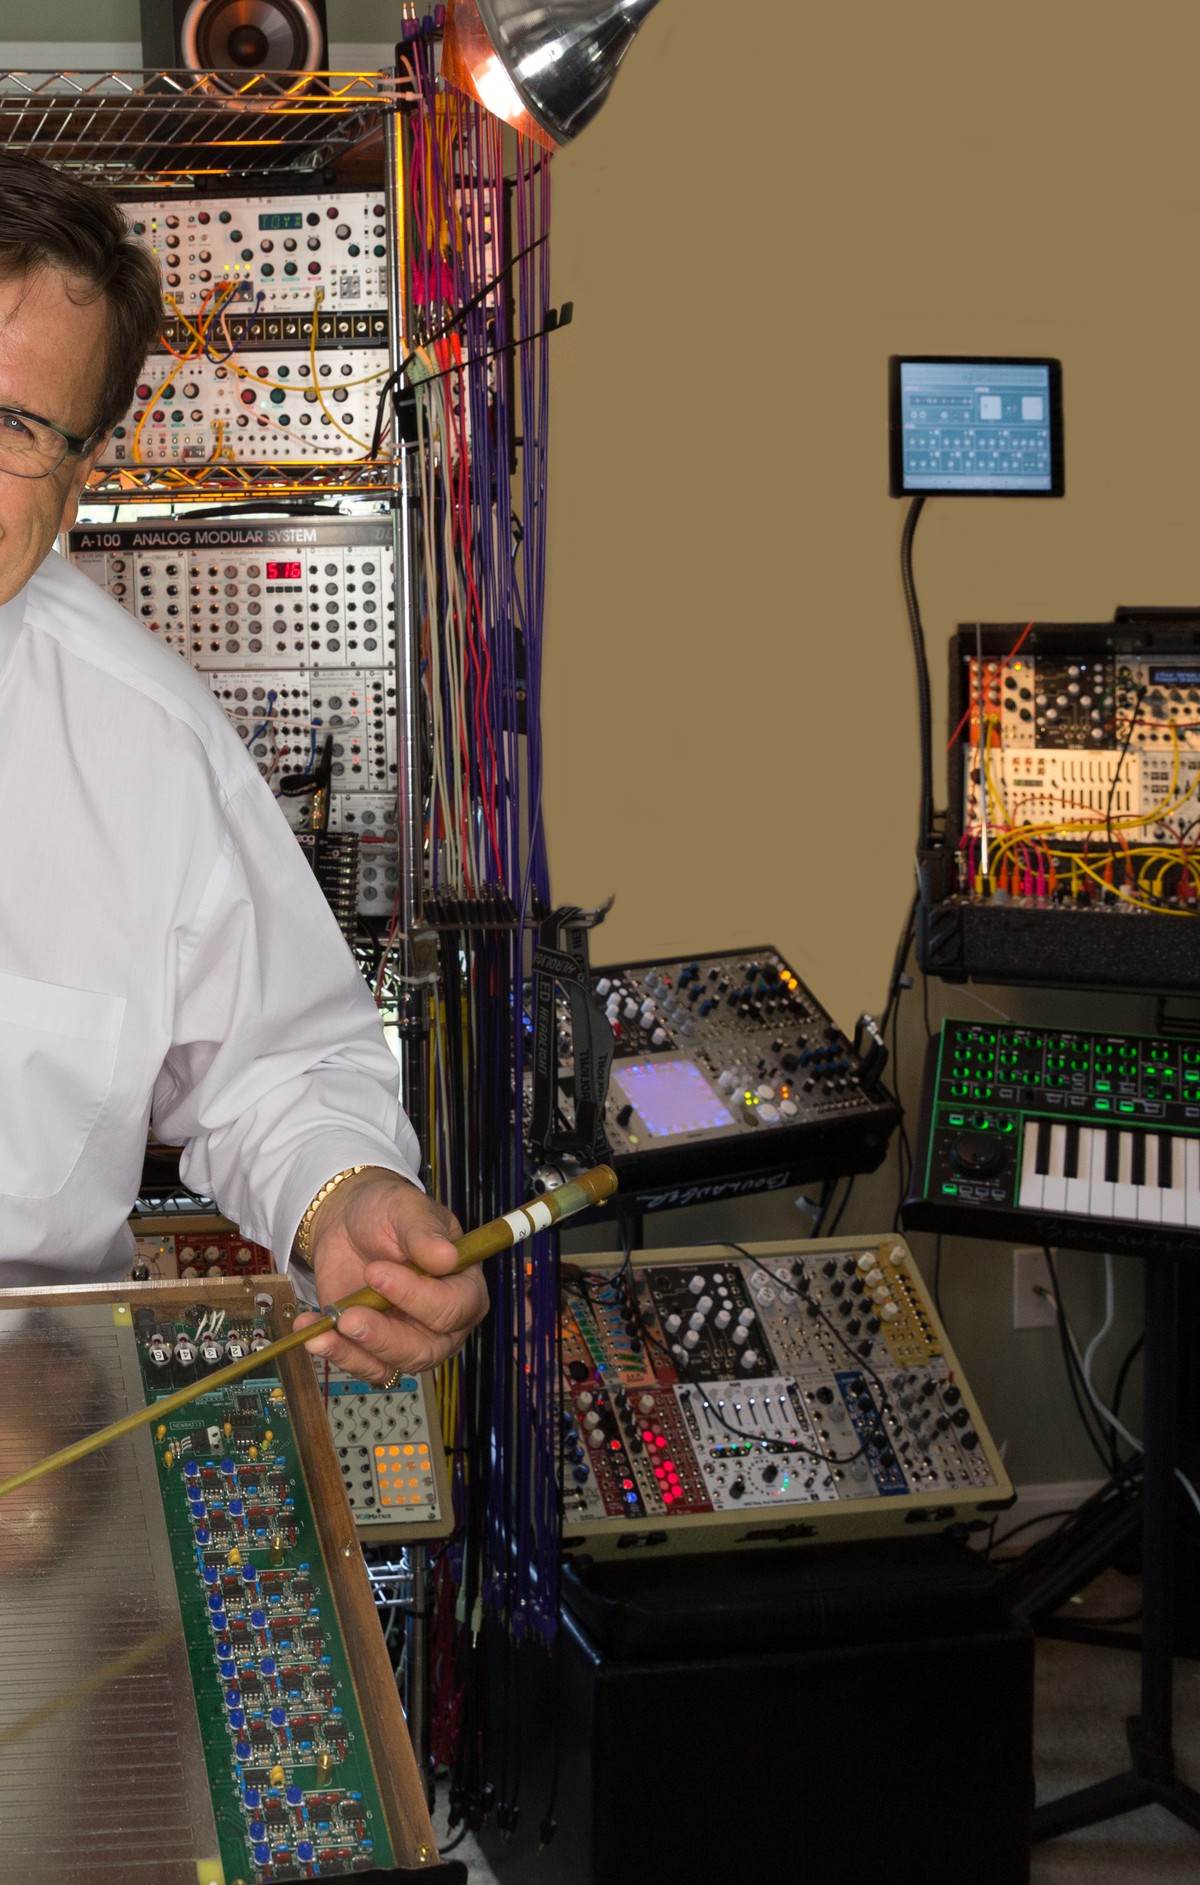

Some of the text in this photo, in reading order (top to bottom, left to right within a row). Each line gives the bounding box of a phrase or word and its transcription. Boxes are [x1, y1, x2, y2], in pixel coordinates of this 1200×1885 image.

[81, 529, 317, 548] A-100 ANALOG MODULAR SYSTEM
[315, 1587, 321, 1595] 2
[325, 1633, 332, 1641] 3
[348, 1732, 355, 1740] 5
[366, 1811, 373, 1819] 6
